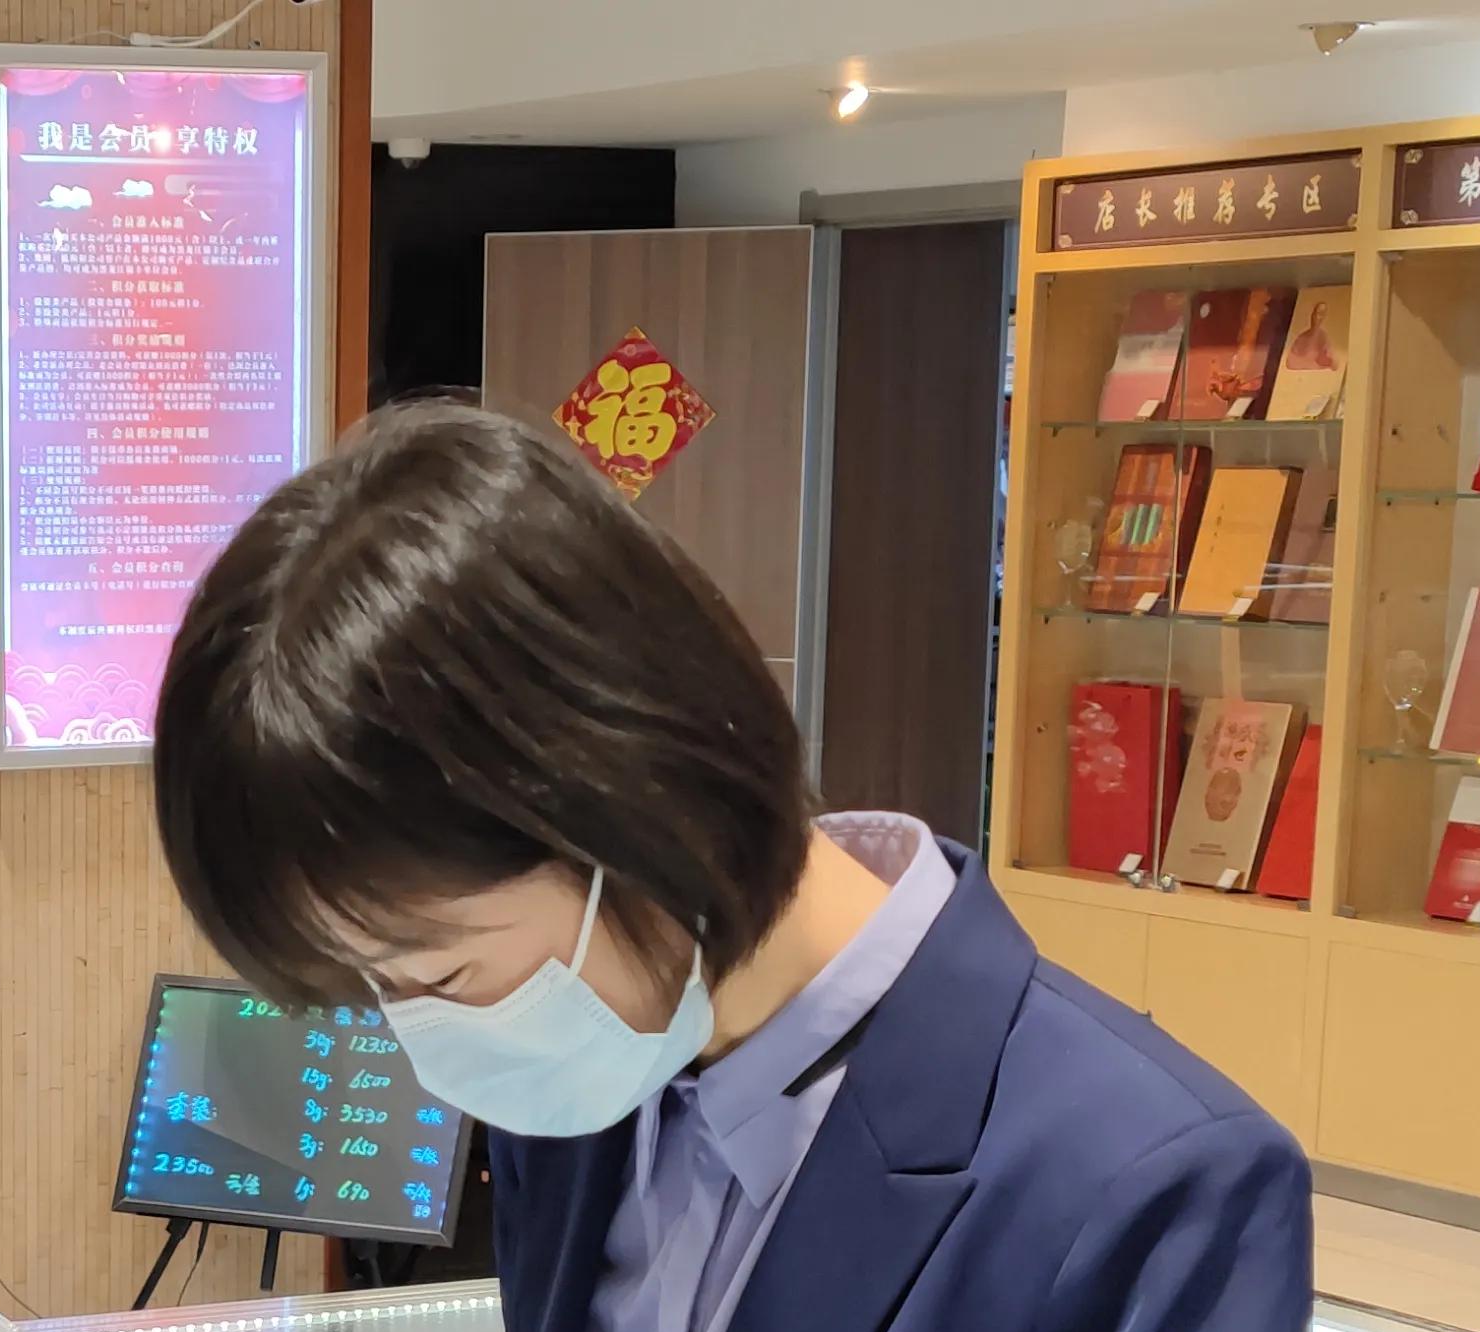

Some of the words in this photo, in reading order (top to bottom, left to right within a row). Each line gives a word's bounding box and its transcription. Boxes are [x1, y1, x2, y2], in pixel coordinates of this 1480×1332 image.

[38, 121, 259, 156] 我是会员享特权
[1094, 173, 1323, 234] 店长推荐专区
[584, 358, 678, 461] 福
